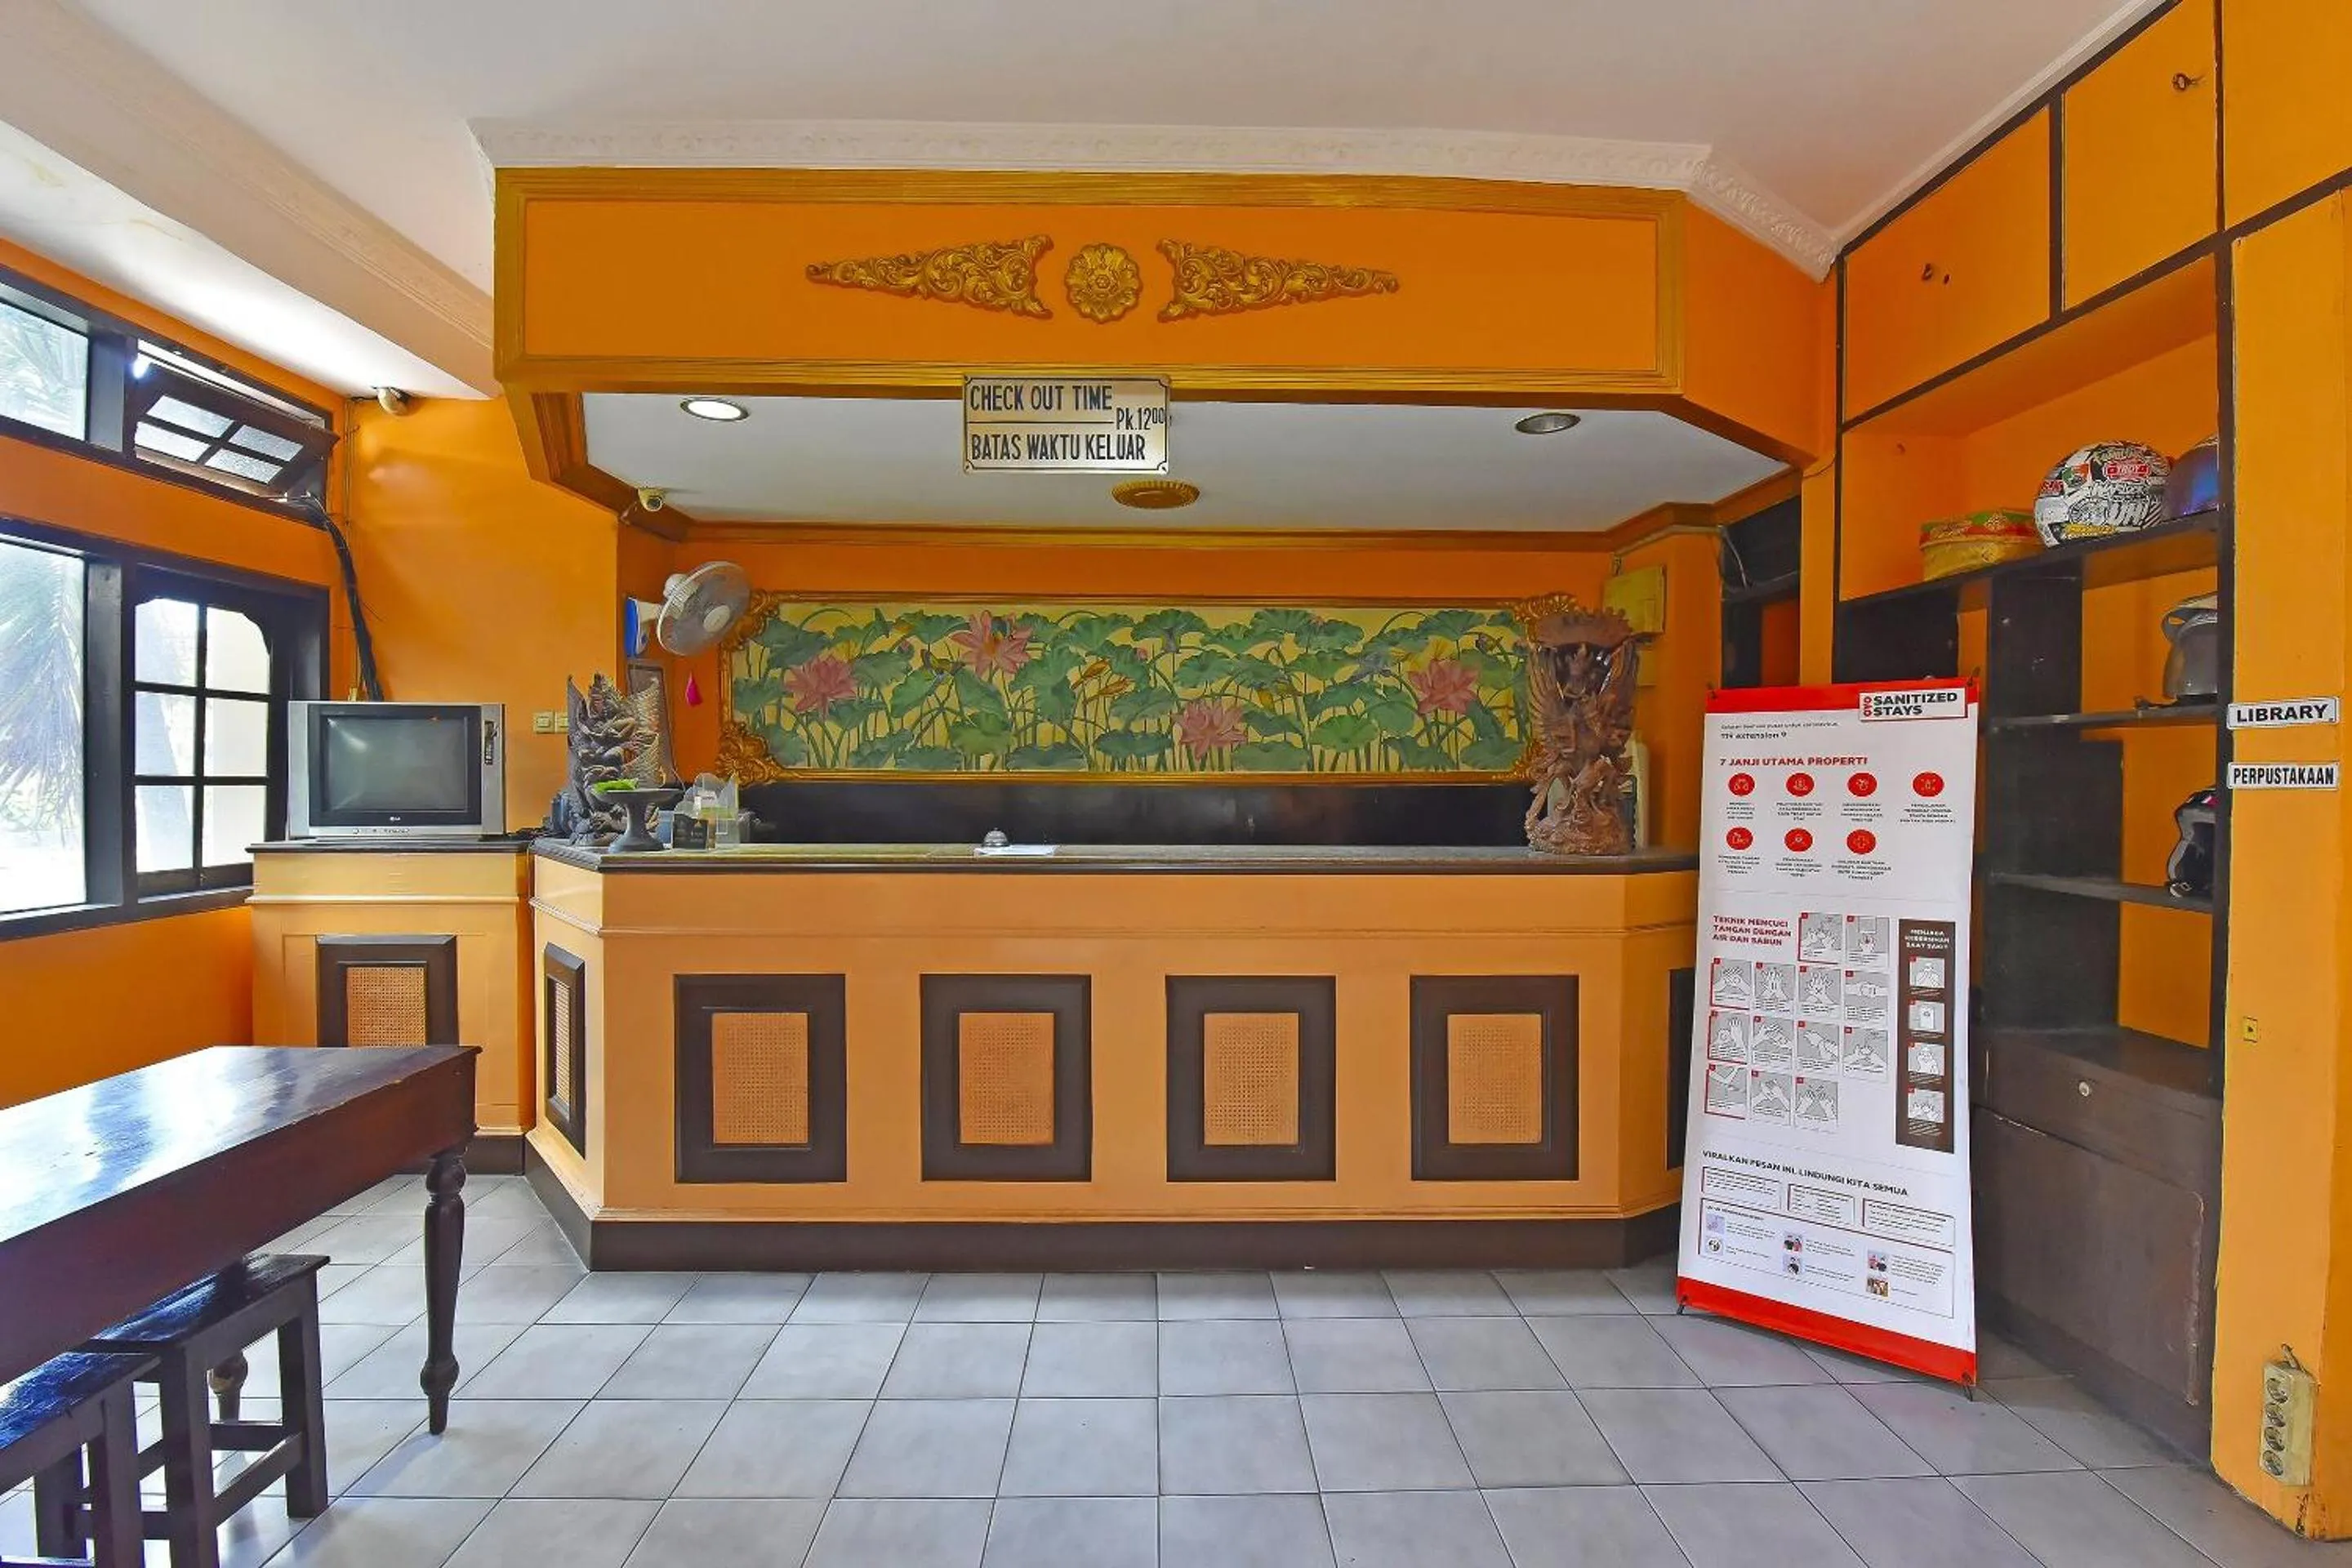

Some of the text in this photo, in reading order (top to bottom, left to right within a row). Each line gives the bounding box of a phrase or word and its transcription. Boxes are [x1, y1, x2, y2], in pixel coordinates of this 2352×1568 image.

[969, 385, 1112, 411] CHECK OUT TIME
[971, 434, 1145, 461] BATAS WAKTU KELUAR
[1873, 692, 1958, 706] SANITIZED
[1873, 705, 1923, 716] STAYS
[2236, 703, 2329, 723] LIBRARY
[1719, 756, 1868, 766] 7 JANJI UTAMA PROPERTI
[2234, 768, 2334, 785] PERPUSTAKAAN
[1713, 915, 1788, 927] TEKNIK MENCUCI
[1713, 924, 1751, 933] TANGAN
[1702, 1150, 1748, 1165] VIRALKAN
[1749, 1160, 1781, 1171] PESAN
[1797, 1169, 1845, 1184] LINDUNGI
[1846, 1177, 1870, 1189] KITA
[1873, 1183, 1909, 1196] SEMUA
